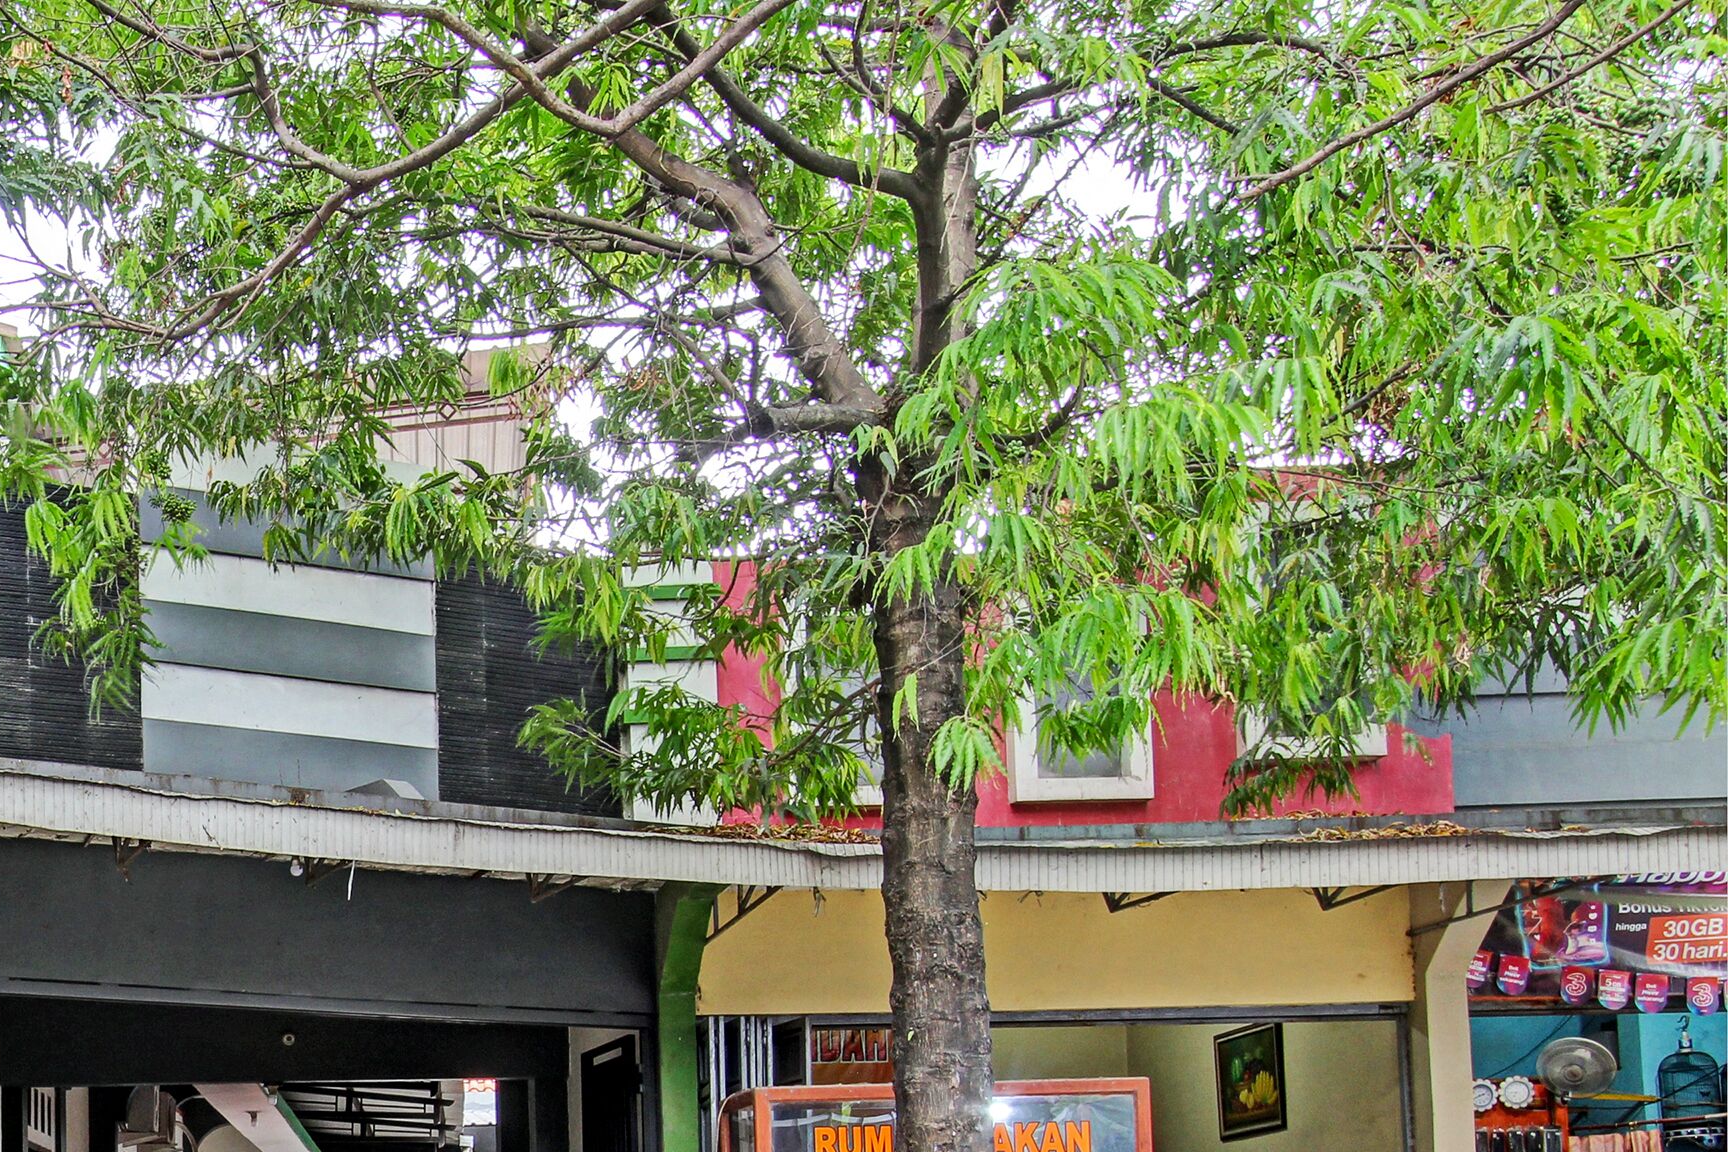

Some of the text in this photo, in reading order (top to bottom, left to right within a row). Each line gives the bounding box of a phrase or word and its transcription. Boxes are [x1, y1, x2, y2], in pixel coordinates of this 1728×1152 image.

[1618, 902, 1672, 914] Bonus
[1615, 922, 1647, 932] hingga
[1663, 917, 1724, 938] 30GB
[1652, 943, 1679, 961] 30
